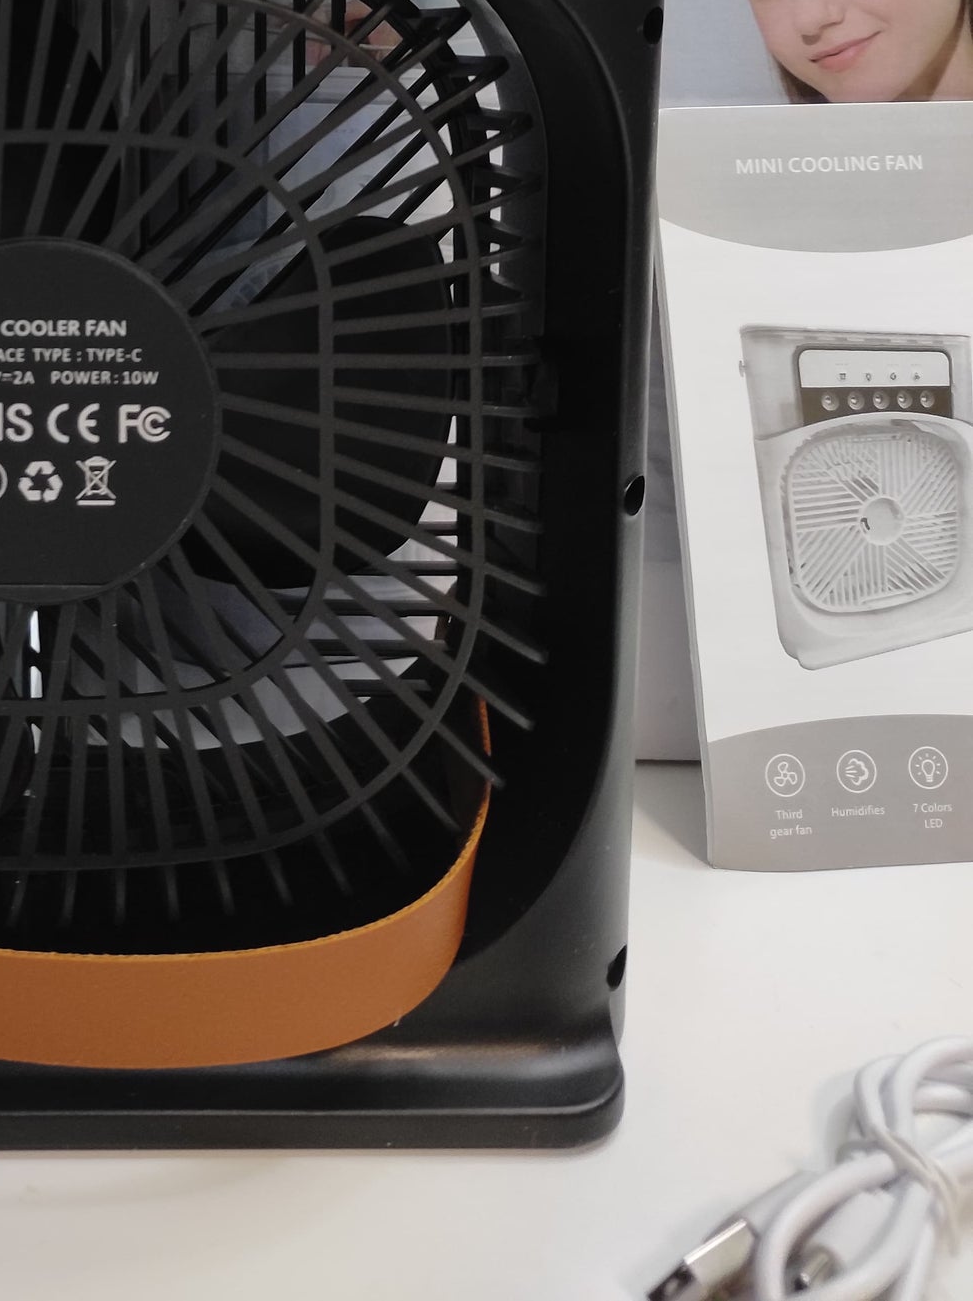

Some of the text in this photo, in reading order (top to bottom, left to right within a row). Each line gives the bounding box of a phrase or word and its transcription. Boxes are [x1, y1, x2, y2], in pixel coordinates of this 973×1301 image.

[735, 154, 924, 175] MINI COOLING FAN
[0, 320, 81, 337] COOLER
[85, 320, 127, 337] FAN
[85, 348, 143, 362] TYPE-C
[122, 371, 159, 385] 10W
[776, 809, 803, 820] Third
[831, 805, 886, 818] Humidifies
[913, 803, 953, 813] 7 Colors
[924, 818, 943, 829] LED
[770, 824, 813, 839] gear fan
